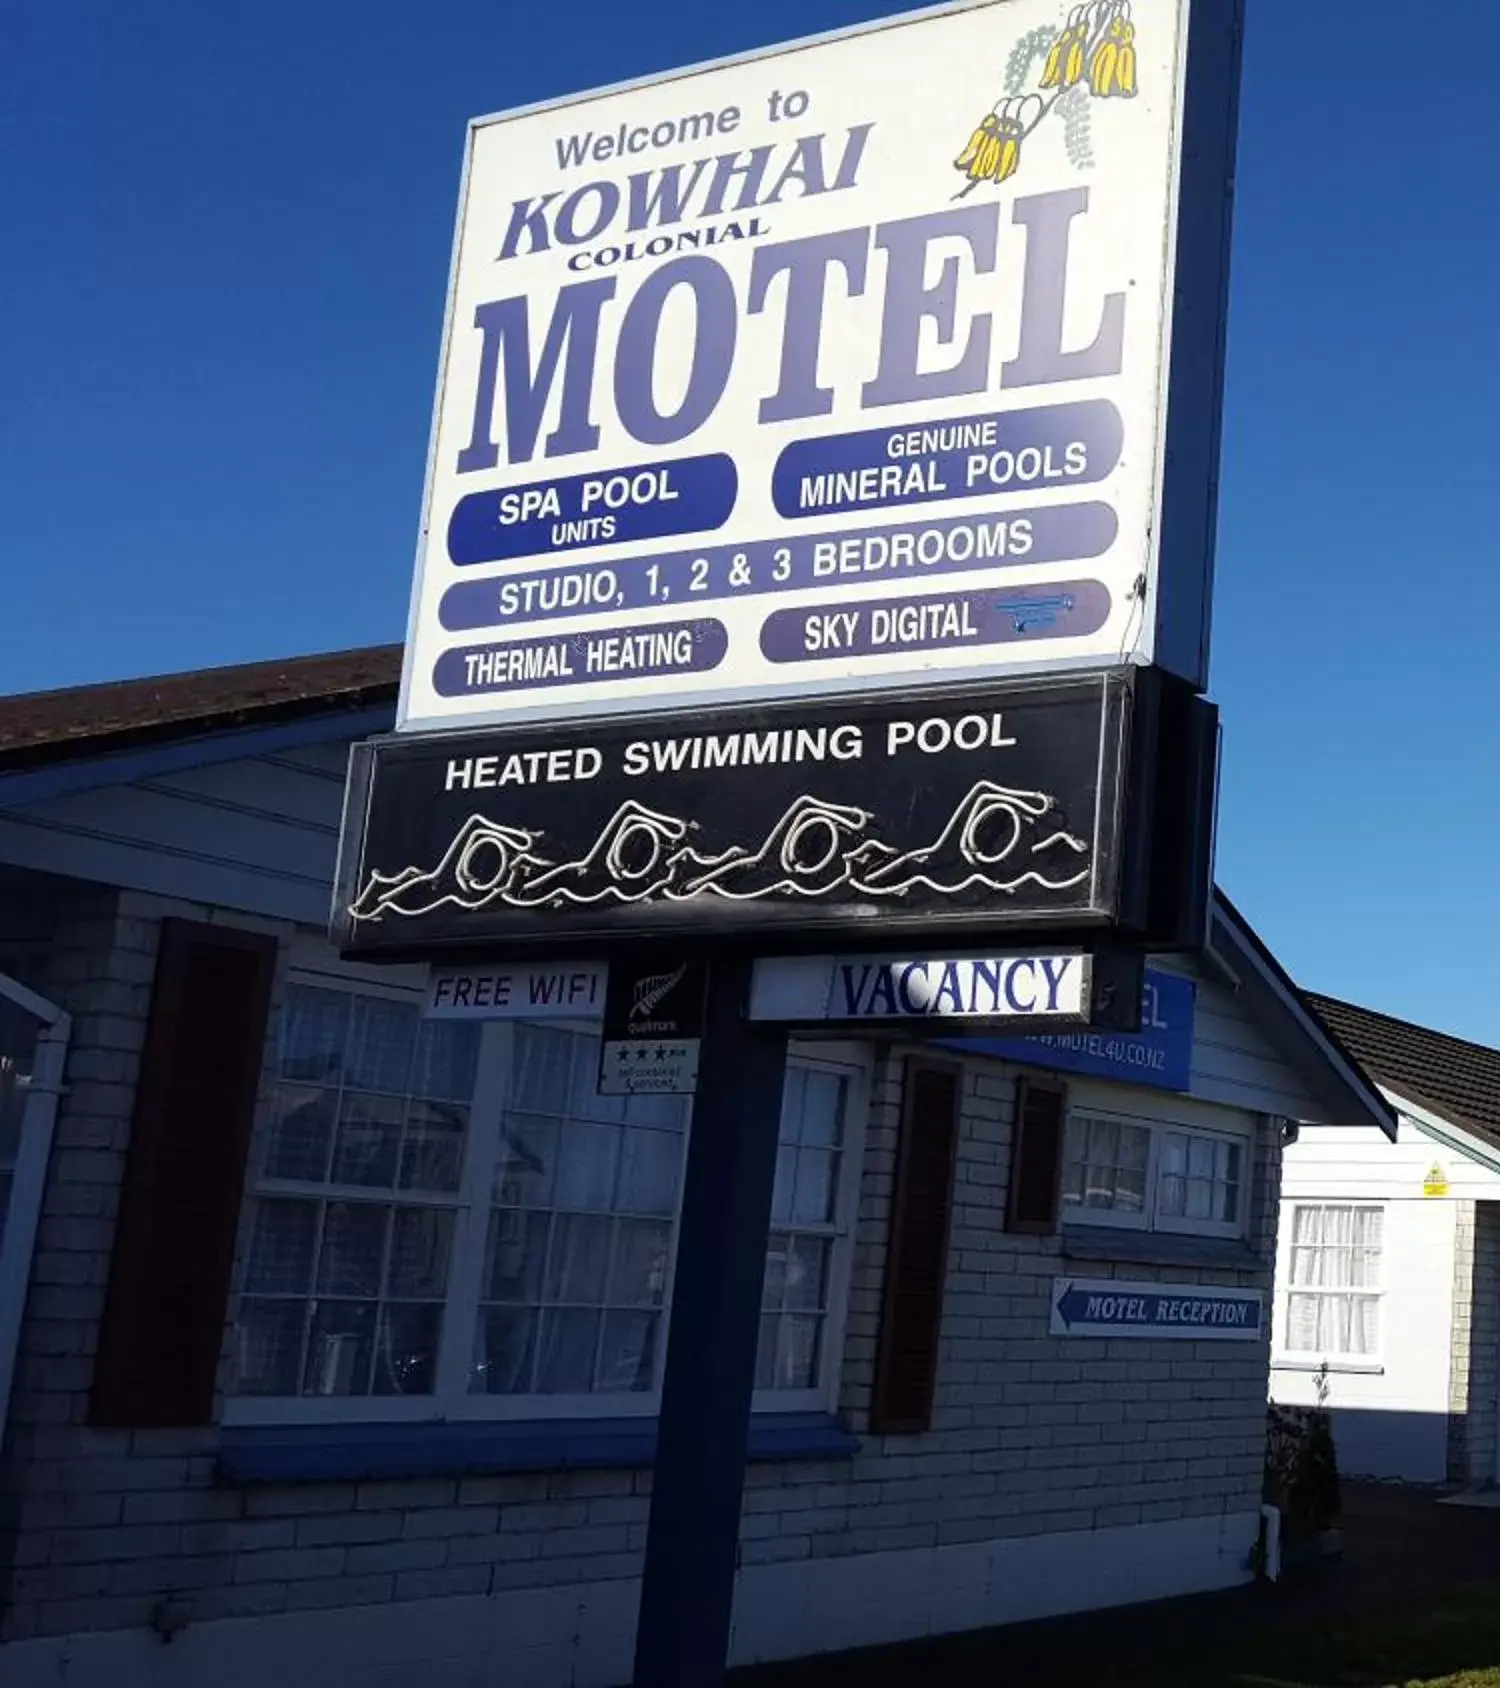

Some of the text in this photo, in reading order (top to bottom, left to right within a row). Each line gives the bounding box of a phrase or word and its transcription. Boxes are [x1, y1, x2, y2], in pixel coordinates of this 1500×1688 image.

[556, 88, 810, 170] Welcome to
[495, 122, 876, 263] KOWHAI
[567, 218, 771, 271] COLONIAL
[456, 186, 1125, 475] MOTEL
[887, 421, 997, 459] GENUINE
[499, 471, 679, 526] SPA POOL
[800, 442, 1088, 508] MINERAL POOLS
[551, 513, 616, 546] UNITS
[500, 518, 1033, 617] STUDIO, 1, 2 & 3 BEDROOMS
[804, 602, 978, 651] SKY DIGITAL
[464, 633, 692, 686] THERMAL HEATING
[445, 713, 1016, 791] HEATED SWIMMING POOL
[434, 973, 598, 1007] FREE WIFI
[840, 958, 1074, 1015] VACANCY
[1085, 1296, 1249, 1324] MOTEL RECEPTION
